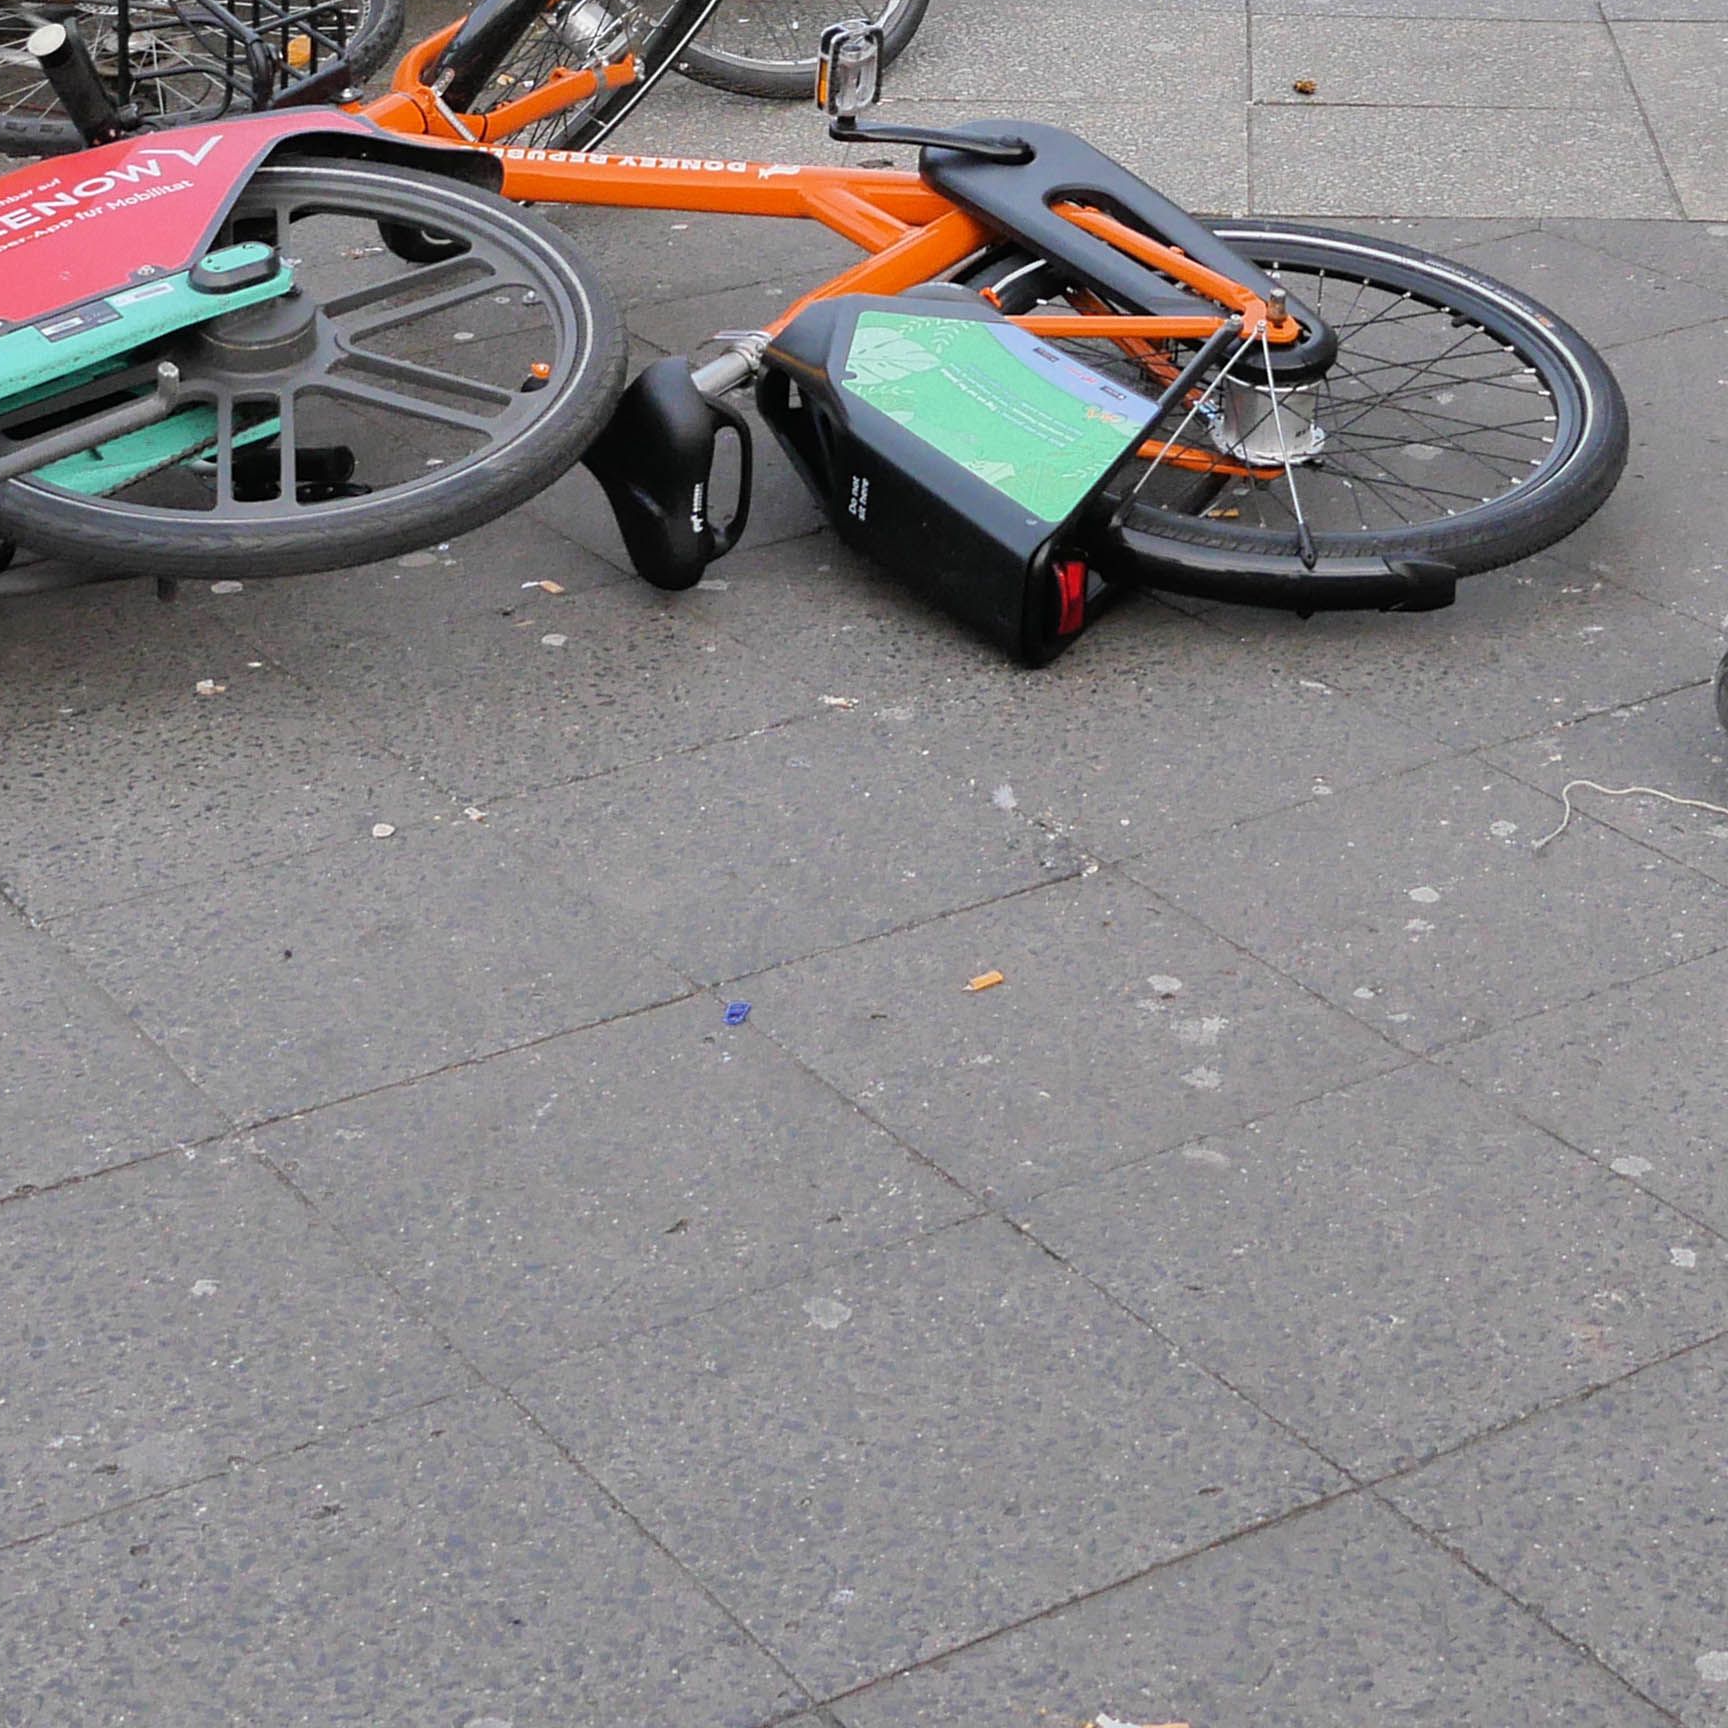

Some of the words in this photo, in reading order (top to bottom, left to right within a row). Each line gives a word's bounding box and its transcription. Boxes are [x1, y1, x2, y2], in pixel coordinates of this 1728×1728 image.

[617, 155, 747, 173] DONKEY
[37, 177, 62, 192] auf
[850, 475, 861, 497] not
[858, 477, 870, 505] here
